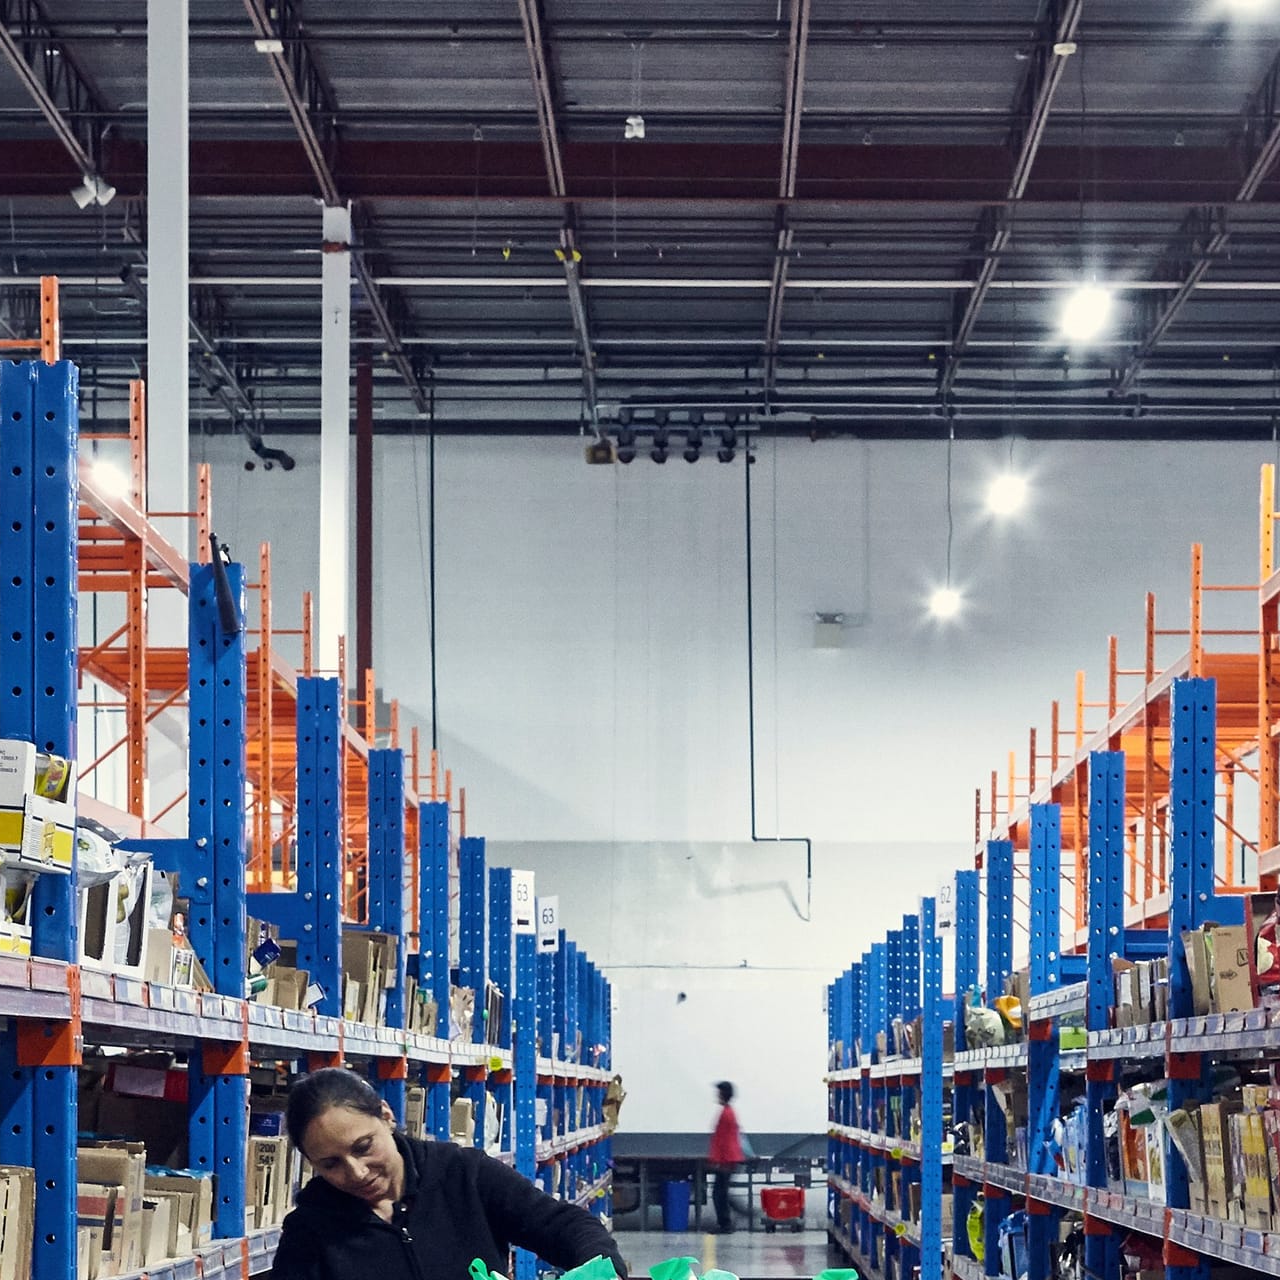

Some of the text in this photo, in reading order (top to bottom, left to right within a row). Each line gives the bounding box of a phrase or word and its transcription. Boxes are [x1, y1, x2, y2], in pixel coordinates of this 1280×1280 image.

[517, 884, 528, 901] 63
[940, 886, 951, 904] 62
[543, 908, 554, 924] 63
